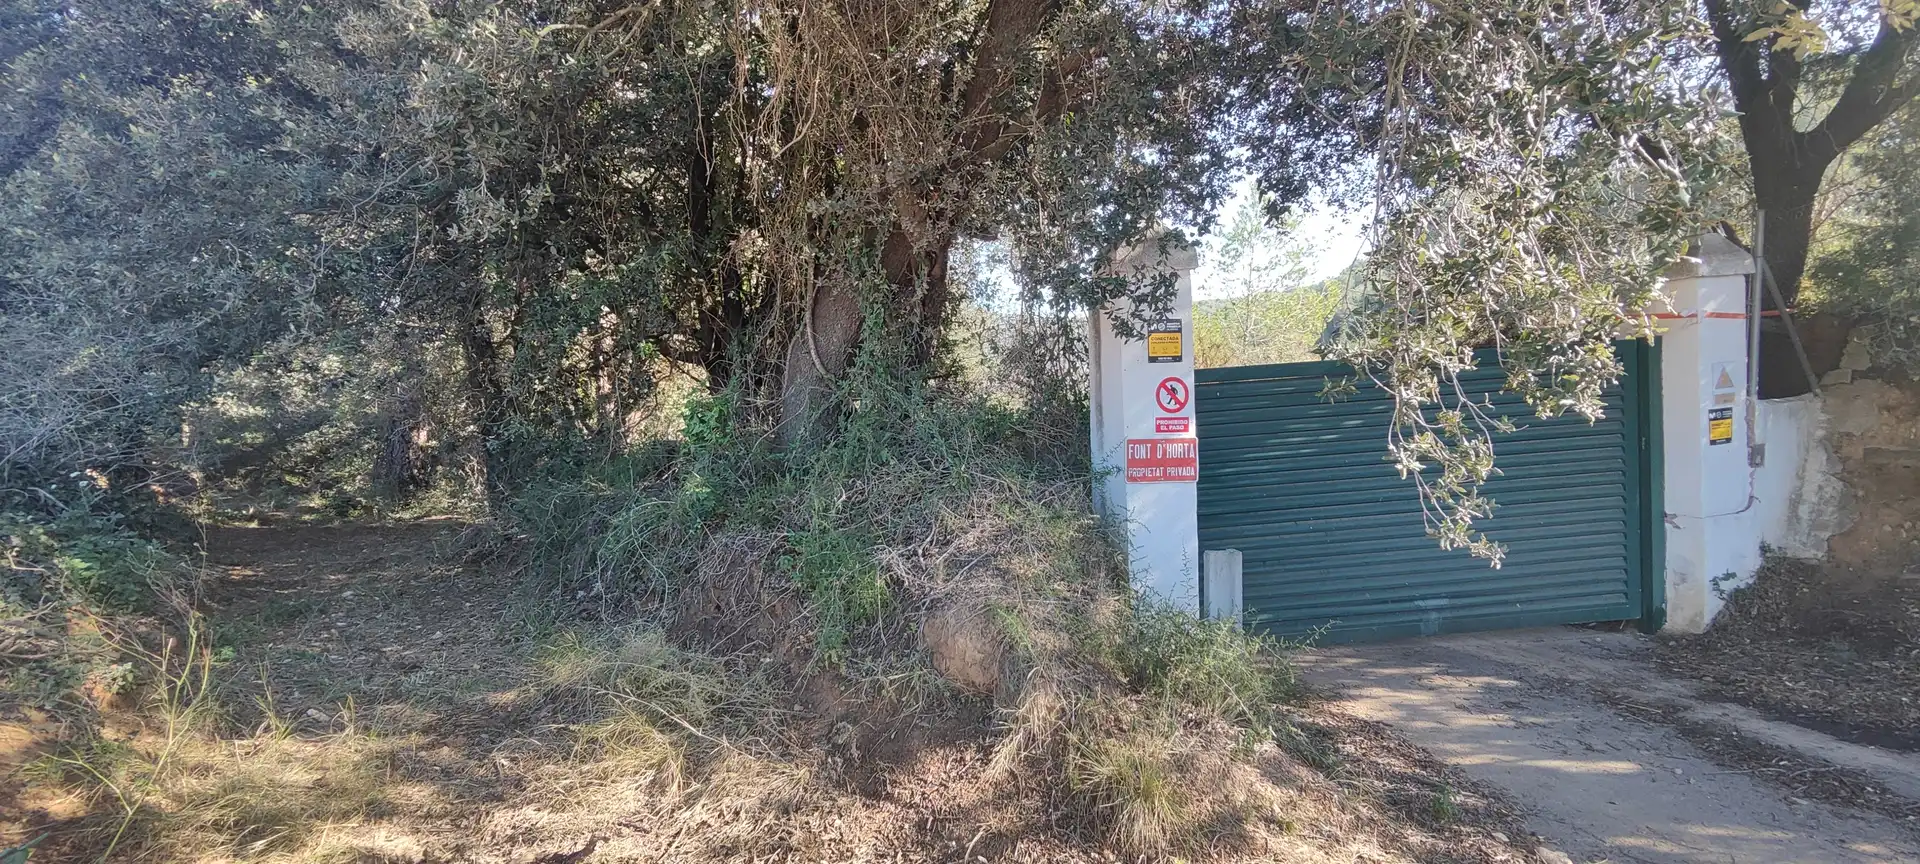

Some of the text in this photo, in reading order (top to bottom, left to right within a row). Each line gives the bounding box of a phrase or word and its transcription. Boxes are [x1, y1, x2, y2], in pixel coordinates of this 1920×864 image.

[1128, 443, 1195, 459] FONT D'HORTA
[1128, 466, 1195, 477] PROPIETAT PRIVADA
